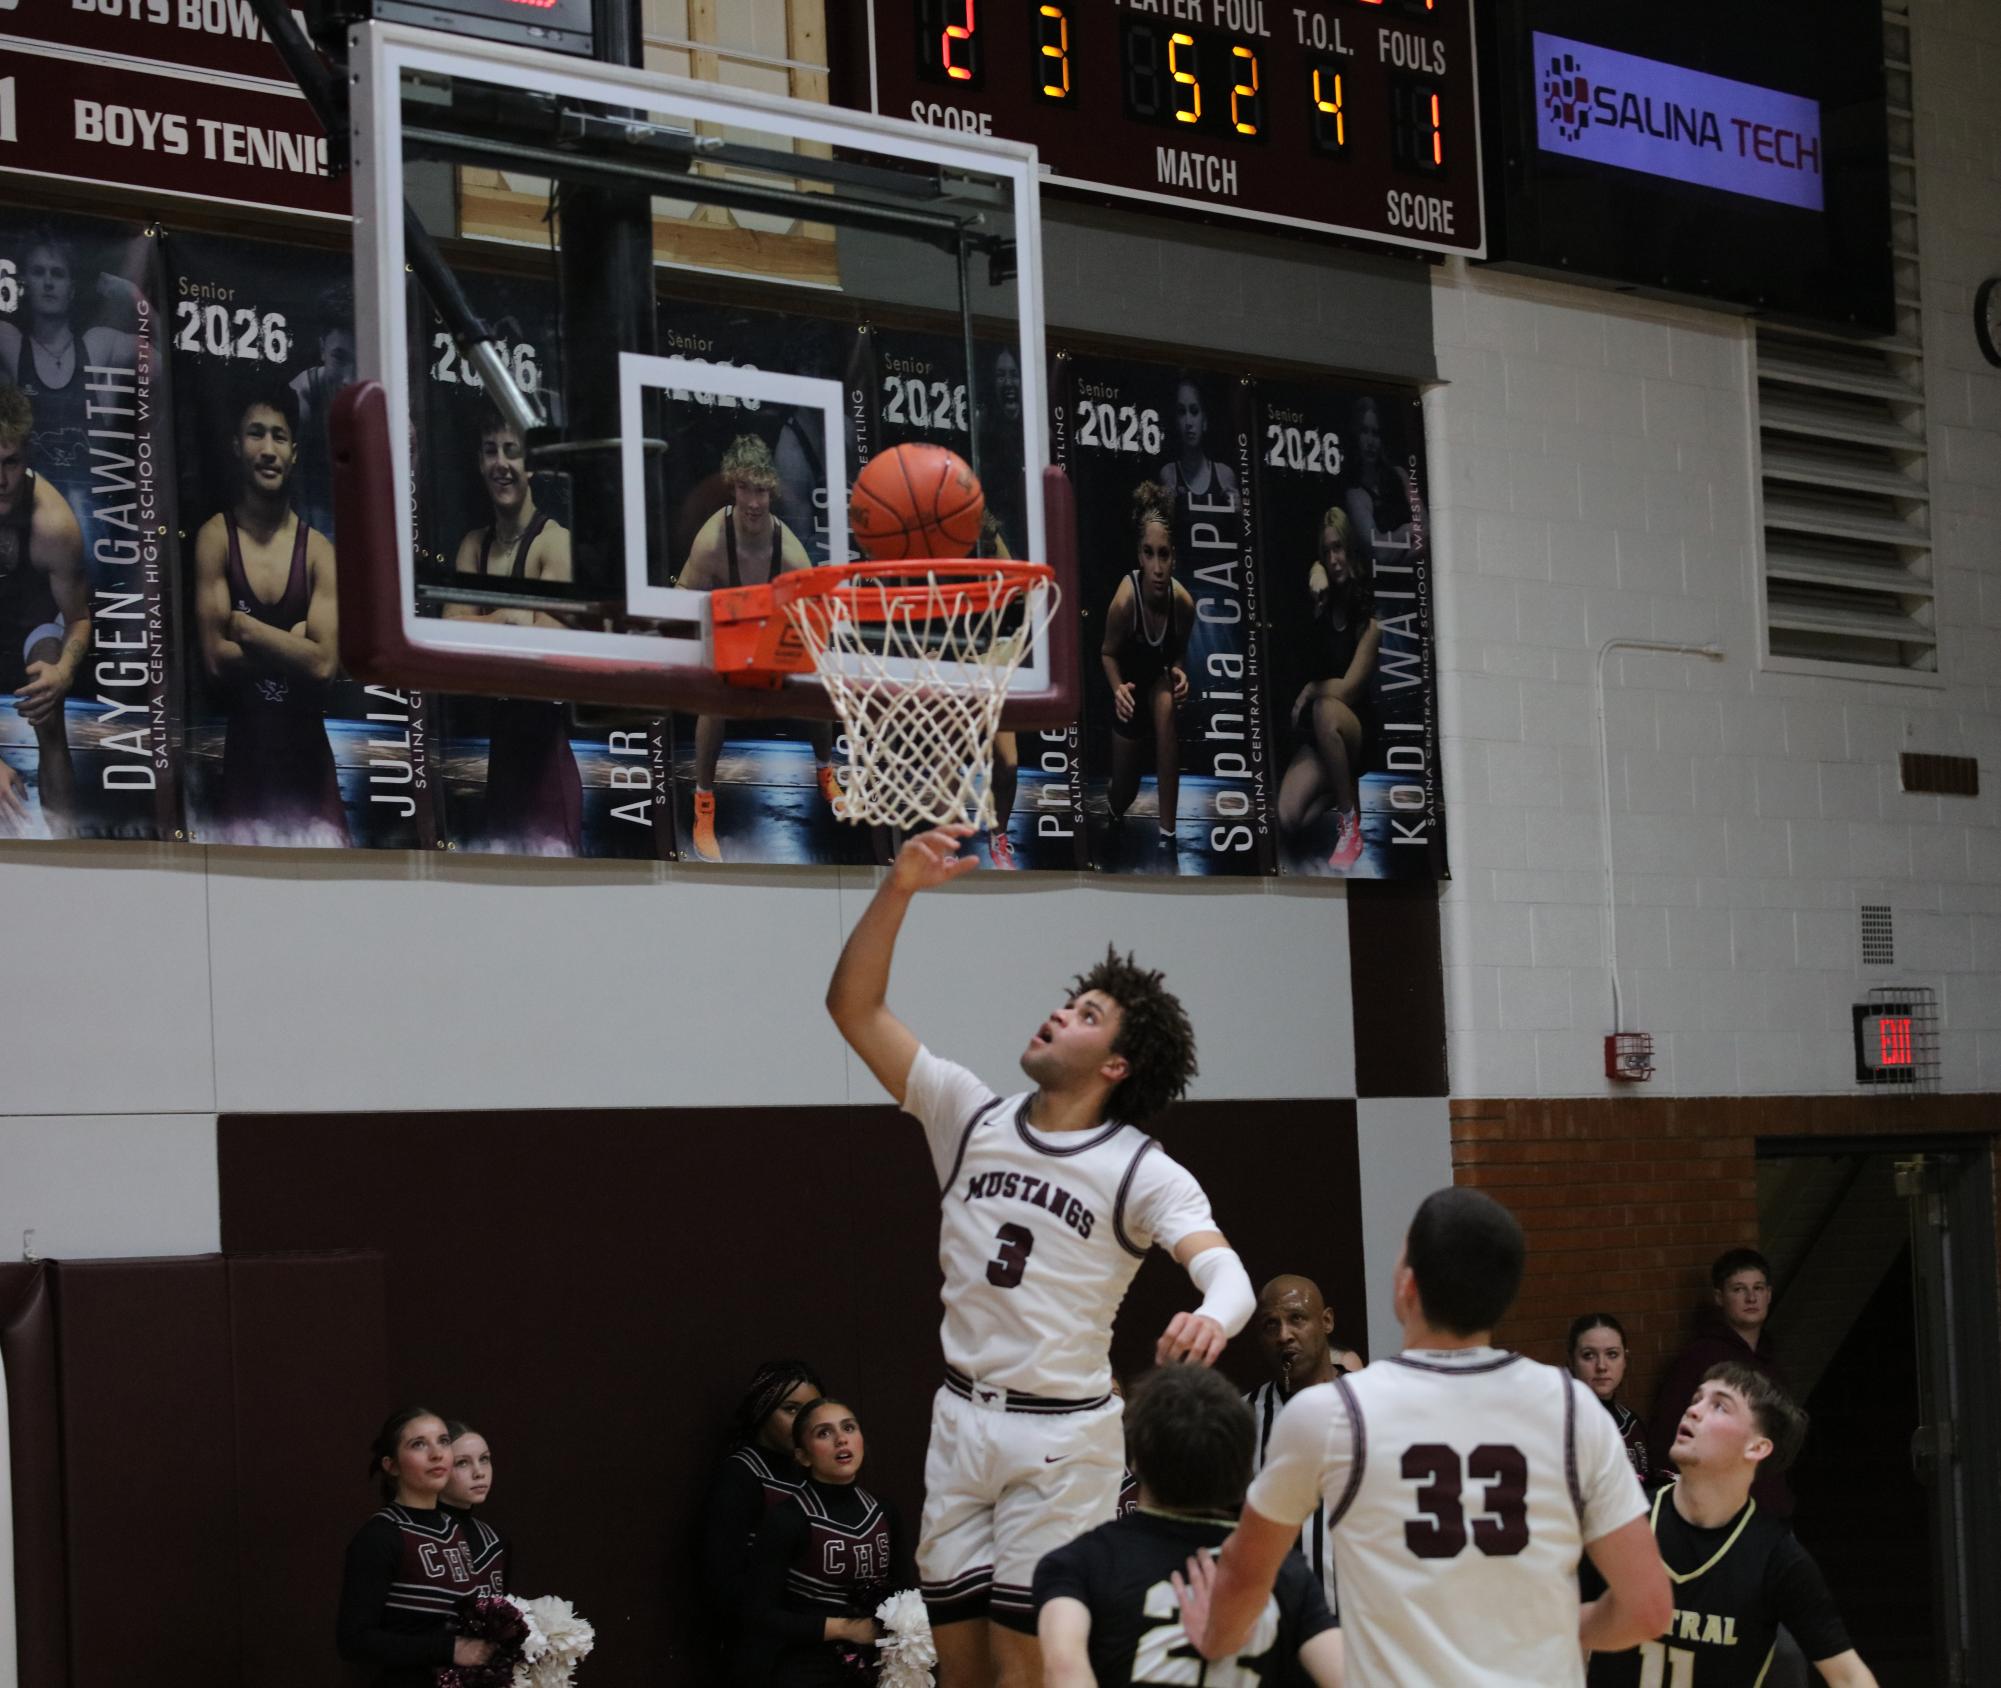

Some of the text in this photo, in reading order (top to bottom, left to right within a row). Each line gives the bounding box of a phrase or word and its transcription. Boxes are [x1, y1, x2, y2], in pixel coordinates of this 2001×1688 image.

[1040, 5, 1069, 97] 3
[1293, 8, 1354, 56] T.O.L.
[1379, 28, 1446, 75] FOULS
[74, 99, 189, 155] BOYS
[1313, 69, 1344, 145] 4
[1431, 94, 1441, 165] 1
[1593, 86, 1819, 174] SALINA TECH
[1156, 146, 1238, 196] MATCH
[1386, 190, 1455, 235] SCORE
[178, 276, 236, 302] Senior
[175, 301, 289, 363] 2026
[667, 329, 714, 351] Senior
[884, 352, 931, 374] Senior
[1077, 378, 1120, 399] Senior
[1075, 400, 1163, 455] 2026
[1265, 425, 1342, 475] 2026
[136, 300, 169, 768] SALINA CENTRAL HIGH SCHOOL WRESTLING
[84, 365, 157, 790] DAYGEN GAWITH
[1238, 433, 1268, 834] SALINA CENTRAL HIGH SCHOOL WRESTLING
[1408, 454, 1436, 827] SALINA CENTRAL HIGH SCHOOL WRESTLING
[1188, 491, 1253, 852] Sophia CAPE
[1371, 529, 1428, 844] KODI WAITE
[412, 718, 427, 789] SALINA
[652, 736, 666, 805] SALINA
[1070, 757, 1083, 823] SALINA
[964, 1172, 1096, 1239] MUSTANGS
[985, 1222, 1034, 1289] 3
[1400, 1444, 1530, 1559] 33
